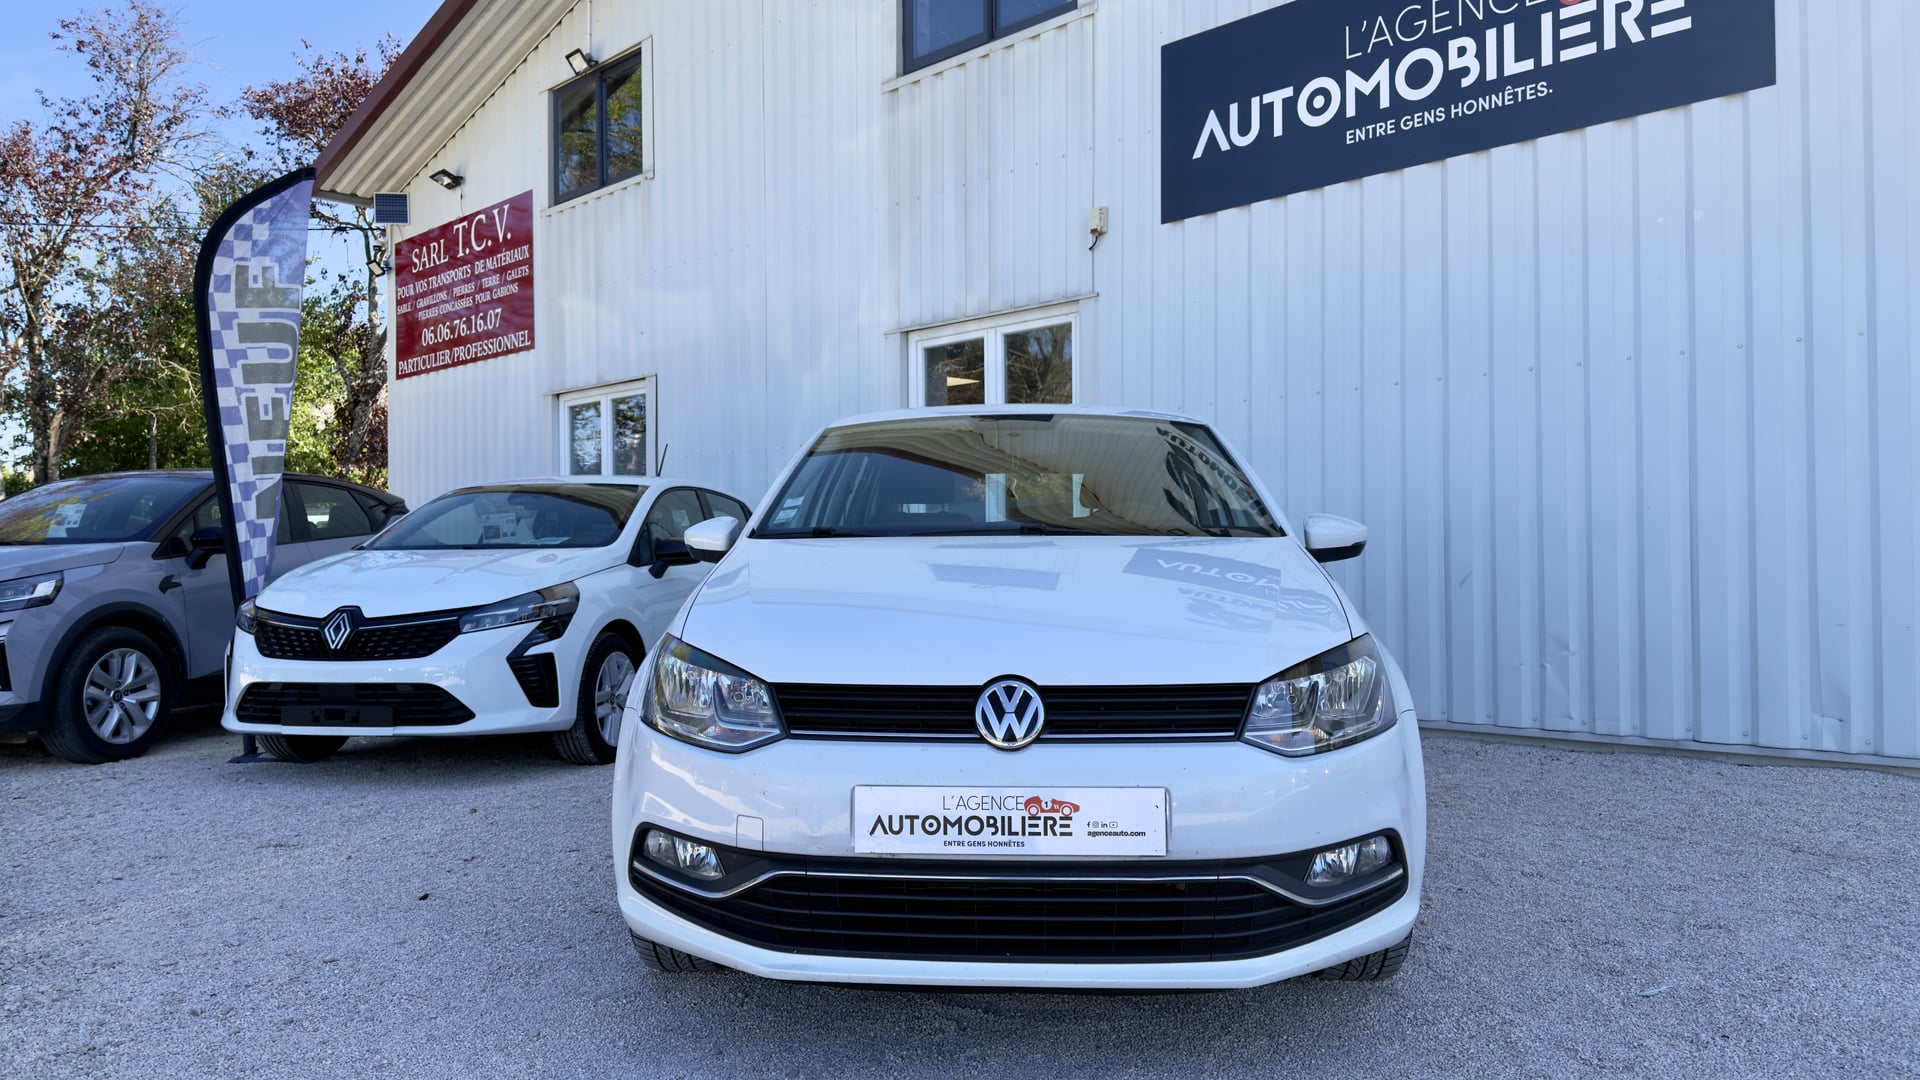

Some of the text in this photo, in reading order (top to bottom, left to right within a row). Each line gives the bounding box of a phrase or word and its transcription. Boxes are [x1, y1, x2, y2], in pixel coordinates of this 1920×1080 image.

[1346, 82, 1553, 144] ENTRE GENS HONNÊTES.
[412, 204, 512, 273] SARL T.C.V.
[397, 245, 530, 300] POUR VOS TRANSPORTS DE MATÉRIAUX
[397, 302, 411, 314] SABLE
[416, 290, 447, 308] GRAVILLONS
[452, 282, 475, 297] PIERRES
[481, 274, 499, 288] TERRE
[506, 265, 529, 281] GALETS
[418, 283, 518, 320] PIERRES CONCASSÉES POUR GABIONS
[421, 308, 502, 346] 06.06.76.16.07
[978, 682, 1041, 744] VW
[942, 795, 1024, 811] L'AGENCE
[988, 839, 1025, 848] HONNÊTES
[1087, 830, 1146, 838] agenceauto.com
